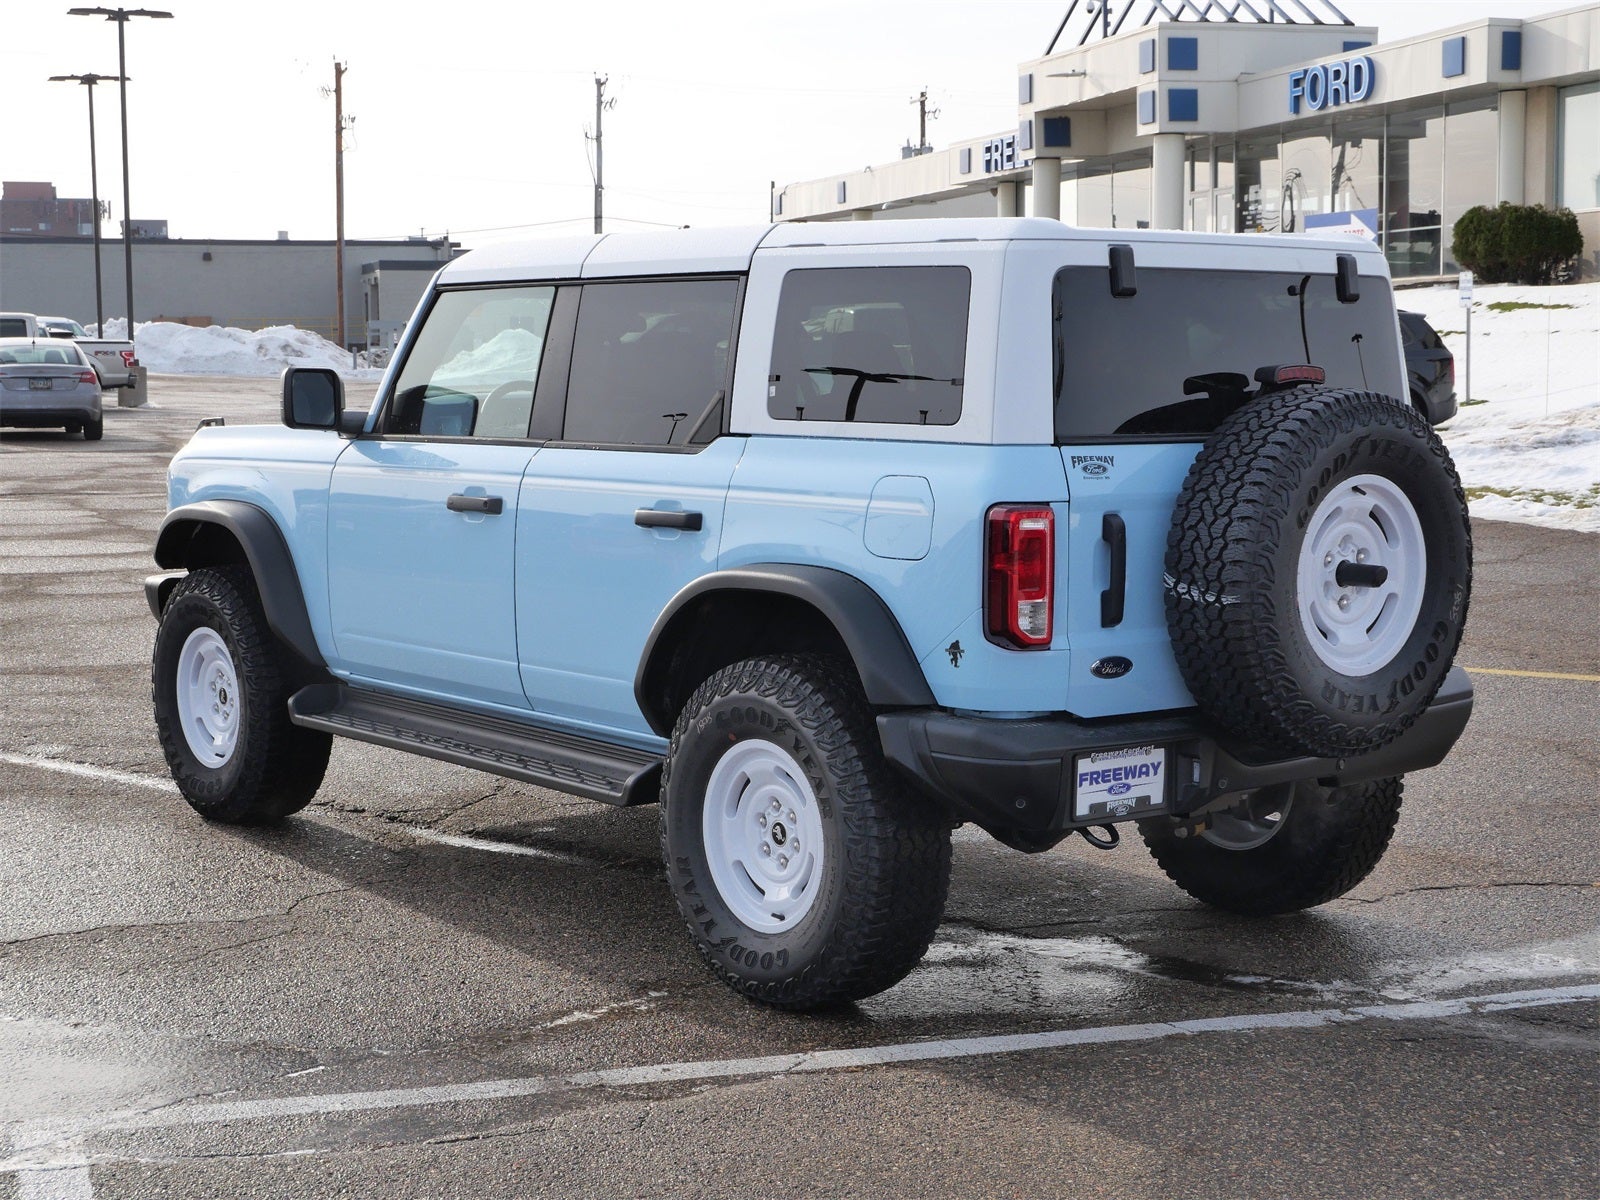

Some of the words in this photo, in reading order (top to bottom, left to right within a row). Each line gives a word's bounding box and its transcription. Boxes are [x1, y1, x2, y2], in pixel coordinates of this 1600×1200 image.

[1288, 55, 1375, 114] FORD
[983, 134, 1034, 174] FREE
[1071, 455, 1114, 469] FREEWAY
[1101, 662, 1125, 675] Ford
[1320, 620, 1449, 713] GOODYEAR
[714, 706, 835, 820] GOODYEAR
[1078, 761, 1162, 788] FREEWAY
[1106, 797, 1137, 813] FREEWAY
[677, 856, 790, 970] GOODYEAR
